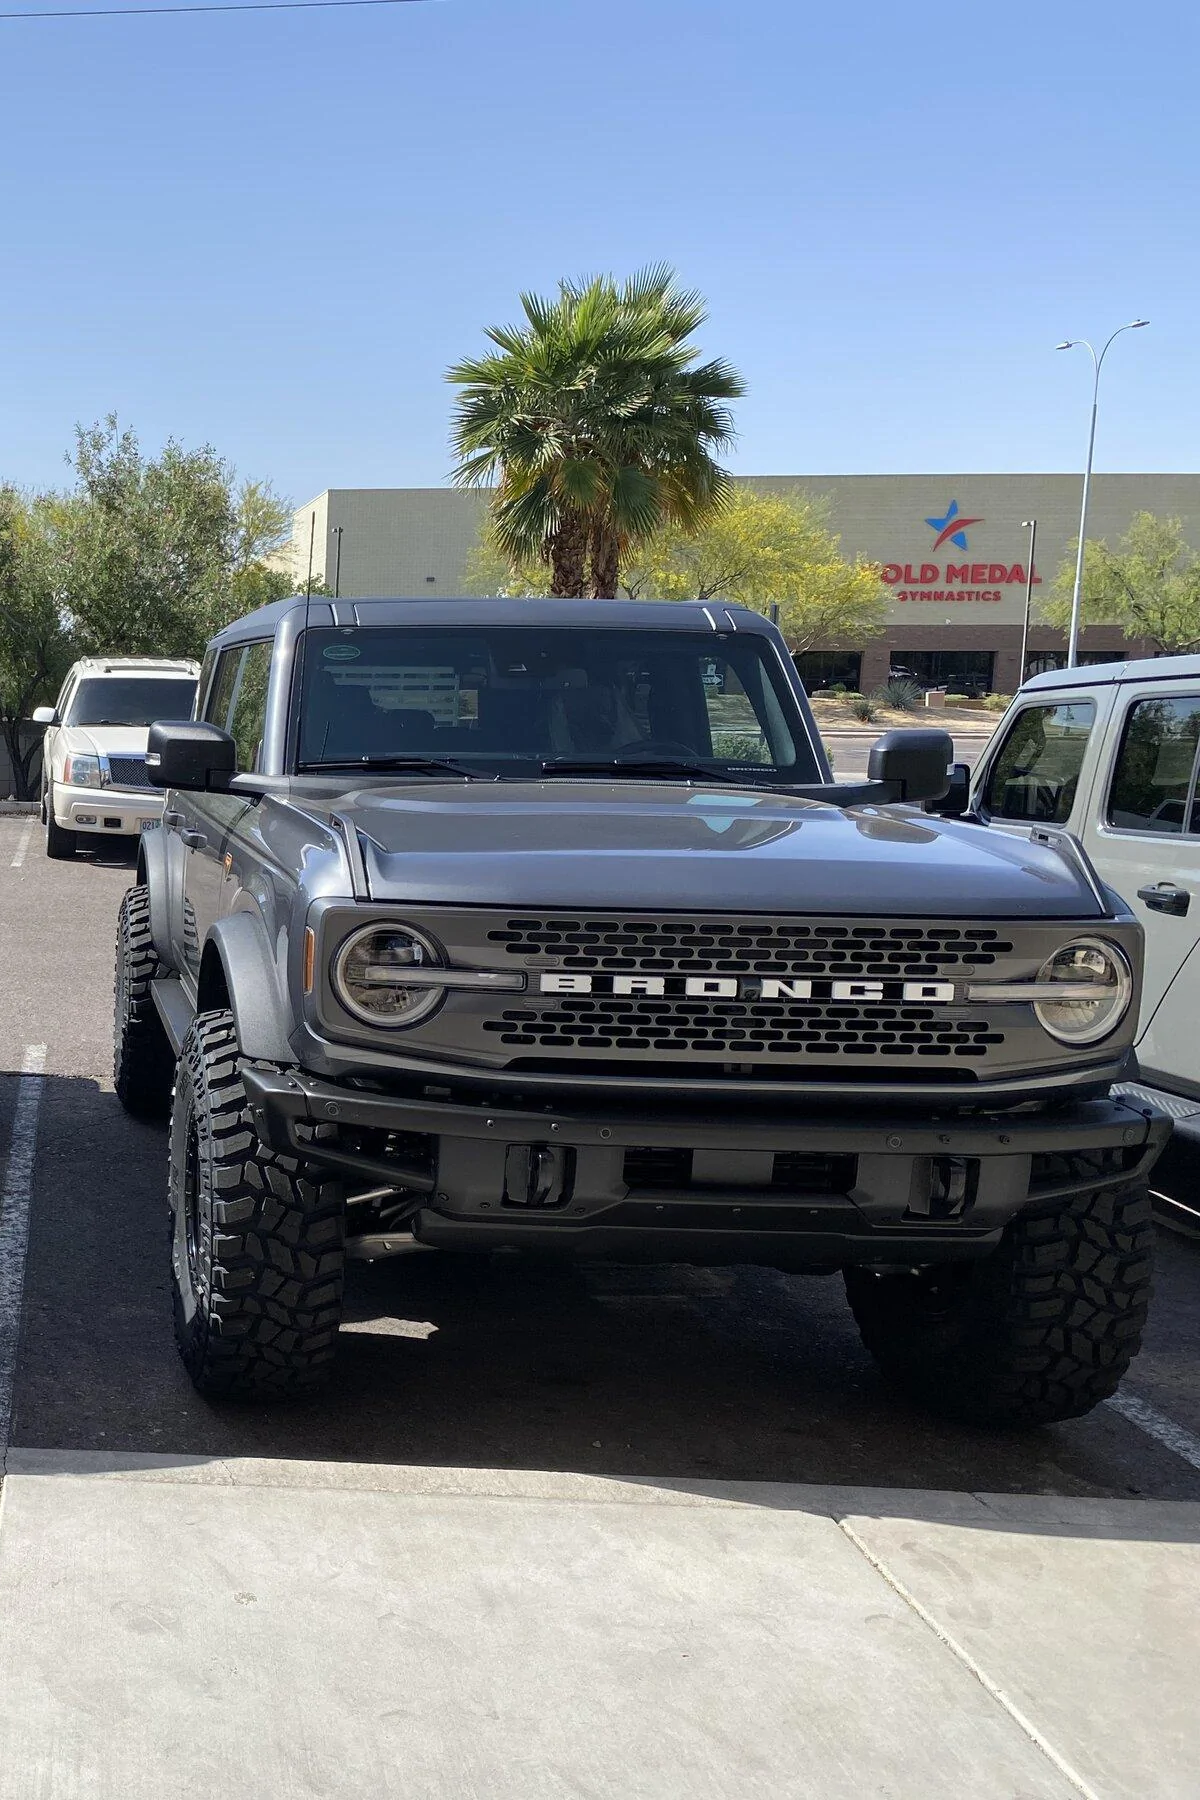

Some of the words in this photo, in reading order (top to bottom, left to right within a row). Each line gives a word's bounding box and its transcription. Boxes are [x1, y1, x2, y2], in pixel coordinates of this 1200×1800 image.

[880, 564, 940, 584] OLD
[946, 564, 1043, 584] MEDAL
[898, 590, 1002, 602] GYMNASTICS
[540, 973, 955, 1002] BRONCO
